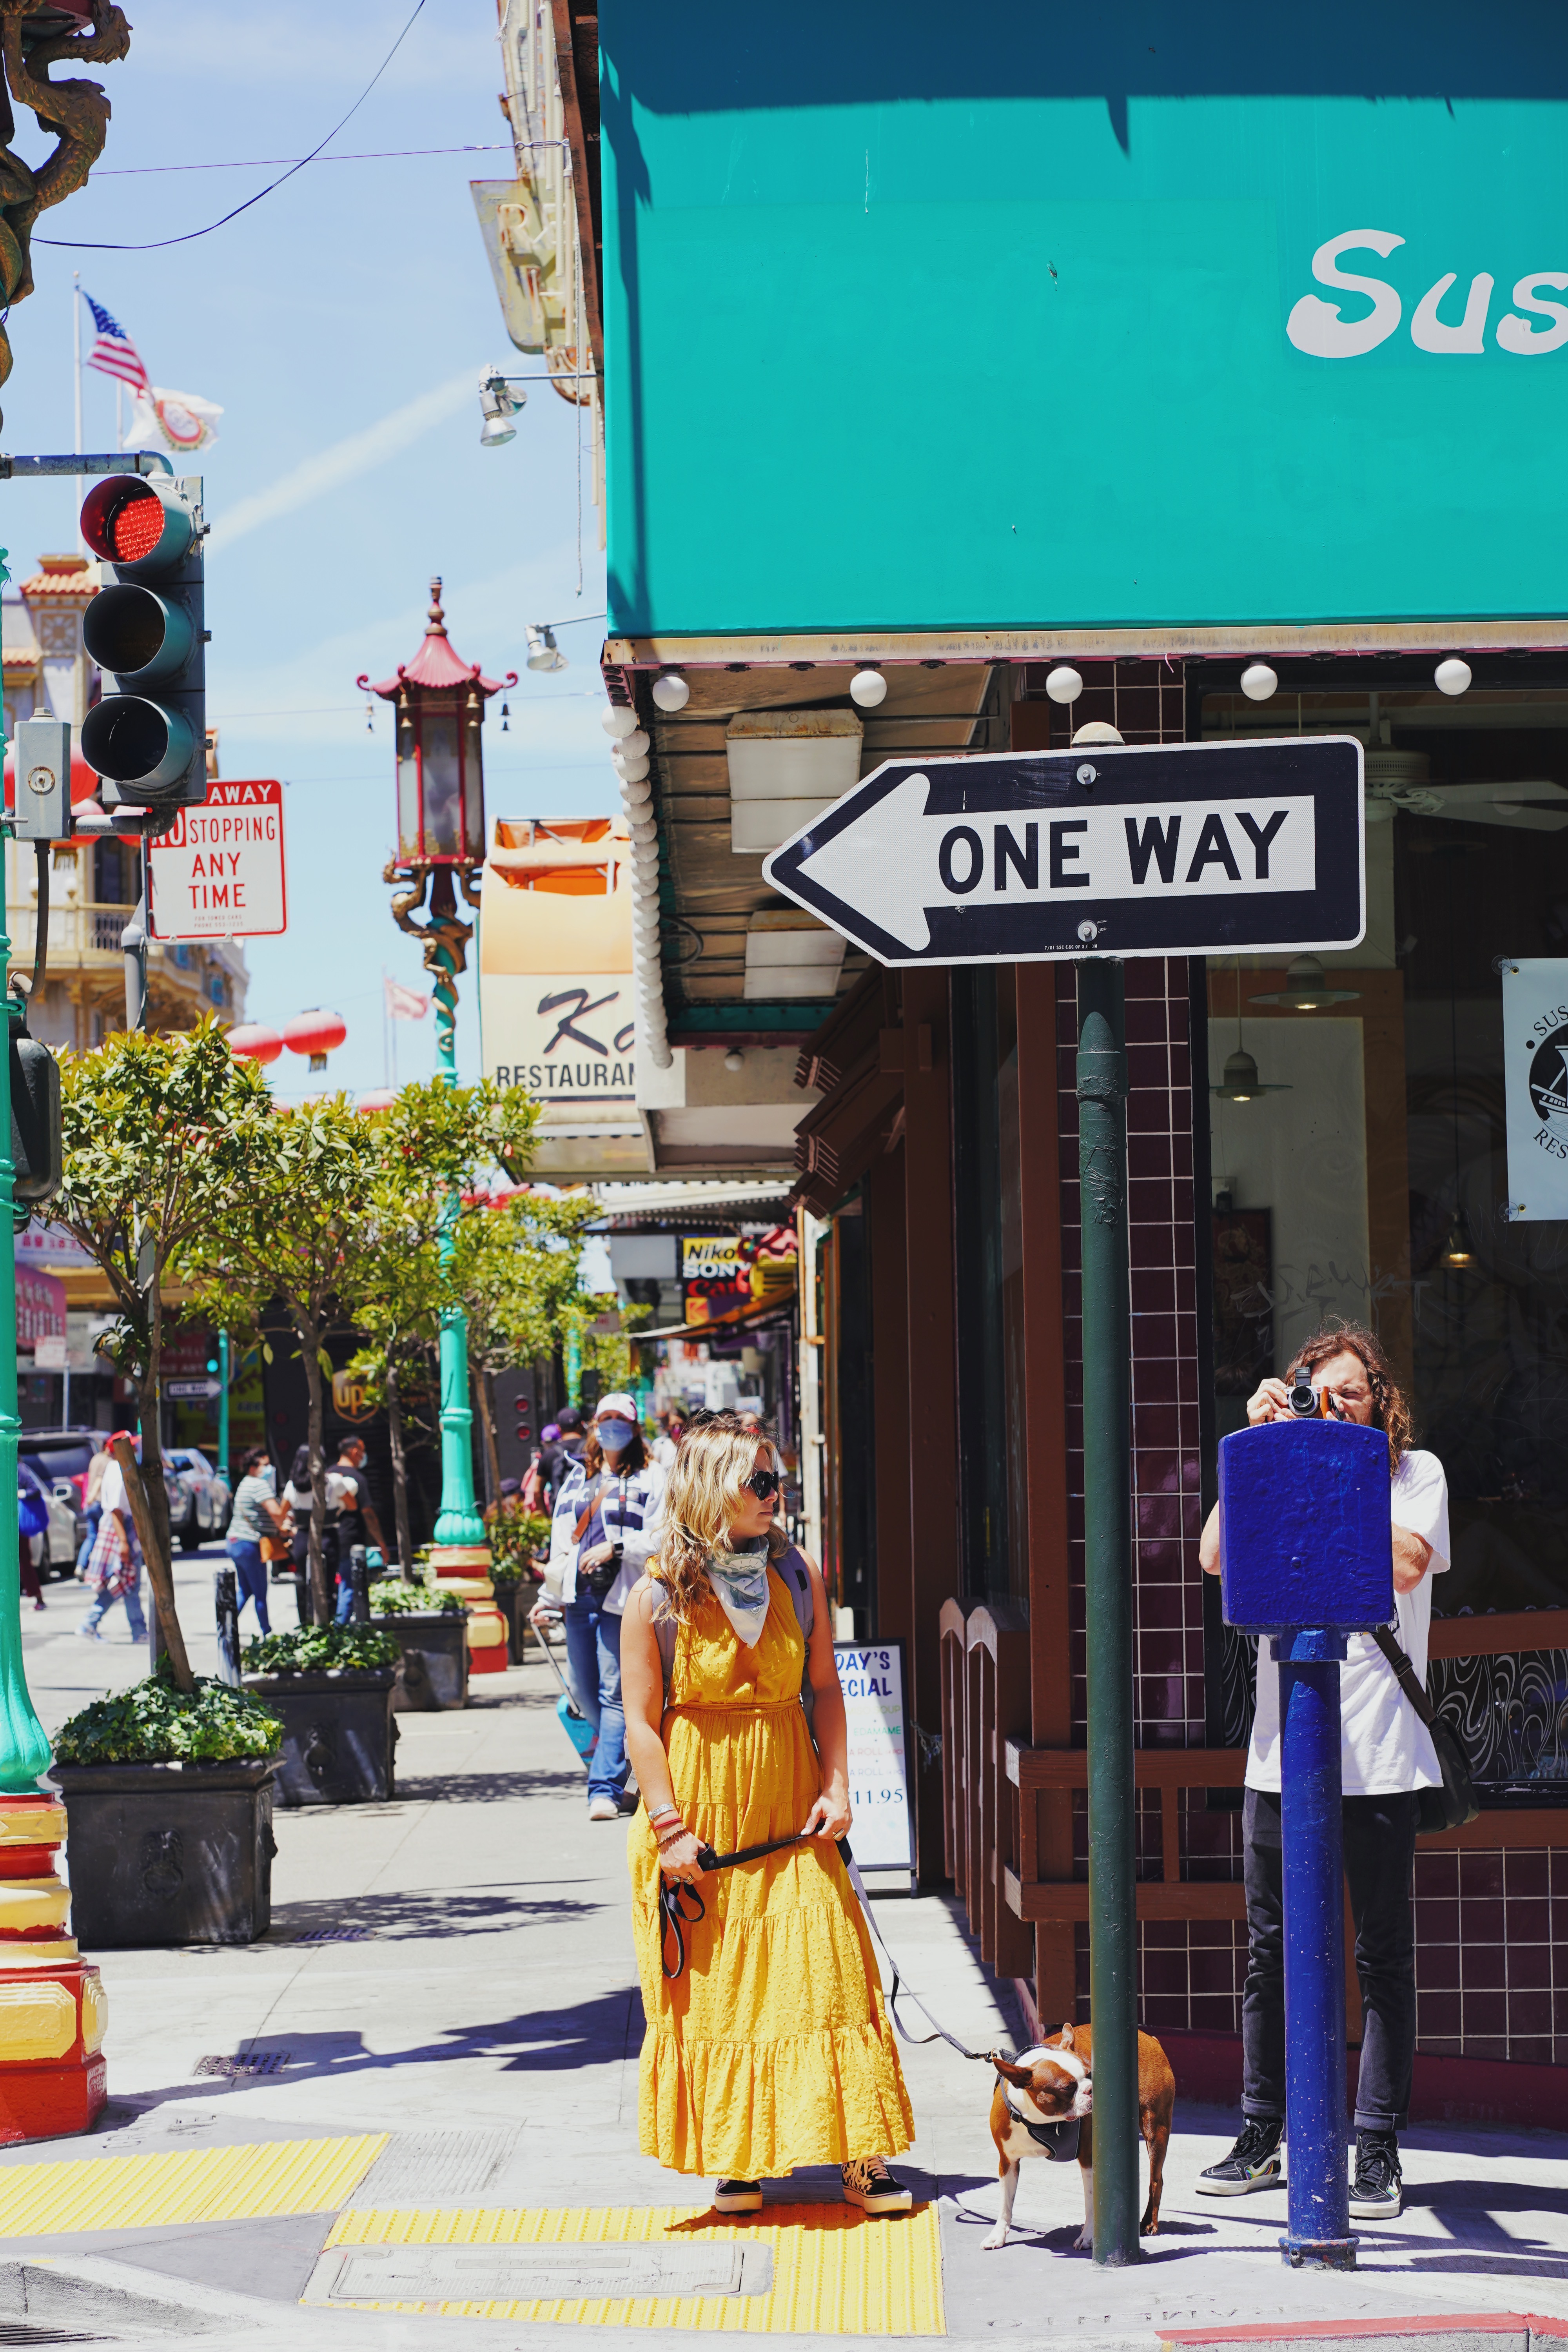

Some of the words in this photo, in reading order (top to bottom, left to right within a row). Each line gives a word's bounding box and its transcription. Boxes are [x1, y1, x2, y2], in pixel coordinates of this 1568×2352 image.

[1286, 229, 1568, 358] Sus
[209, 784, 272, 804] AWAY
[151, 811, 185, 846] O
[190, 816, 275, 843] STOPPING
[192, 852, 241, 877] ANY
[939, 820, 1090, 895] ONE
[1124, 810, 1290, 884] WAY
[188, 884, 246, 909] TIME
[1534, 1005, 1568, 1036] SUS
[1533, 1127, 1568, 1159] RES
[682, 1262, 752, 1278] SONY
[873, 1705, 901, 1714] SOUP
[854, 1726, 902, 1736] EDAMAME
[848, 1788, 903, 1804] 11.95
